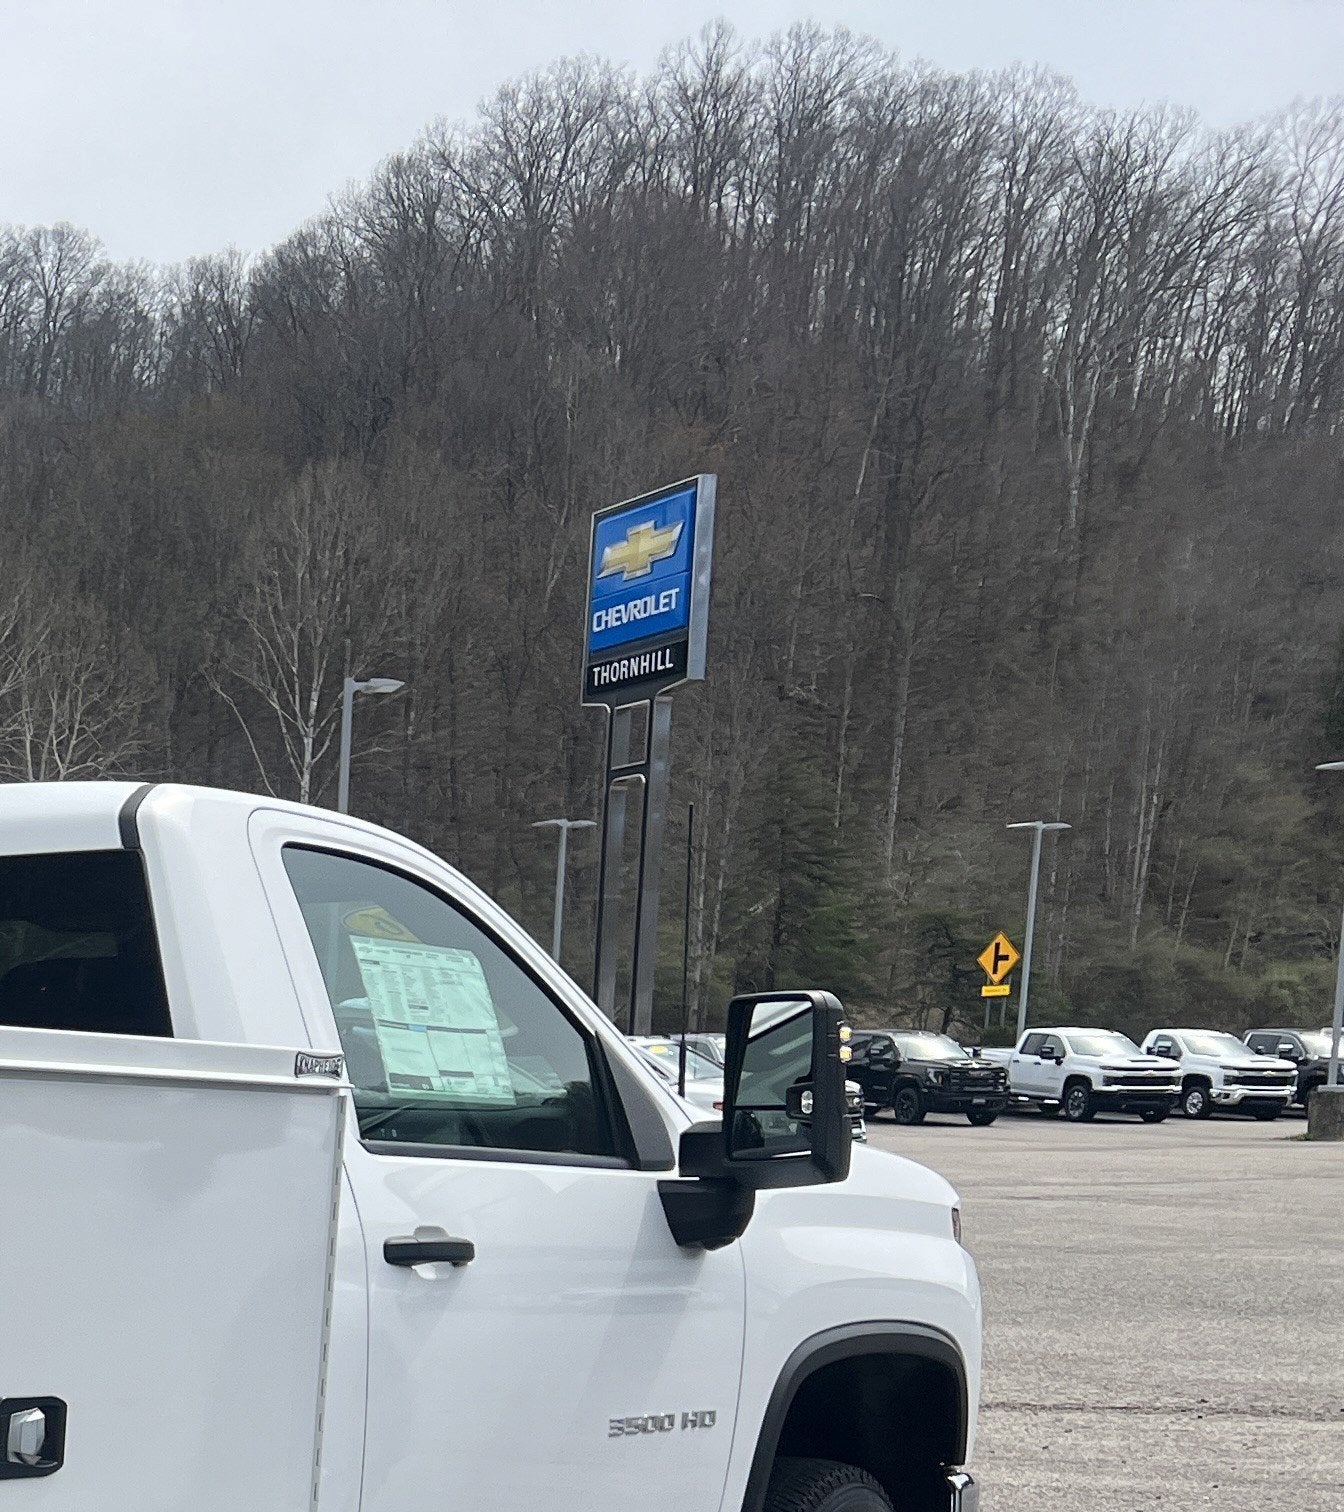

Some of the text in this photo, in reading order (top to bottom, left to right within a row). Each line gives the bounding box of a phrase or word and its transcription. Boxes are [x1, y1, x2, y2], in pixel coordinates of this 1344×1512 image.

[592, 588, 679, 632] CHEVROLET
[592, 648, 674, 686] THORNHILL
[609, 1410, 716, 1438] 3500 HD
